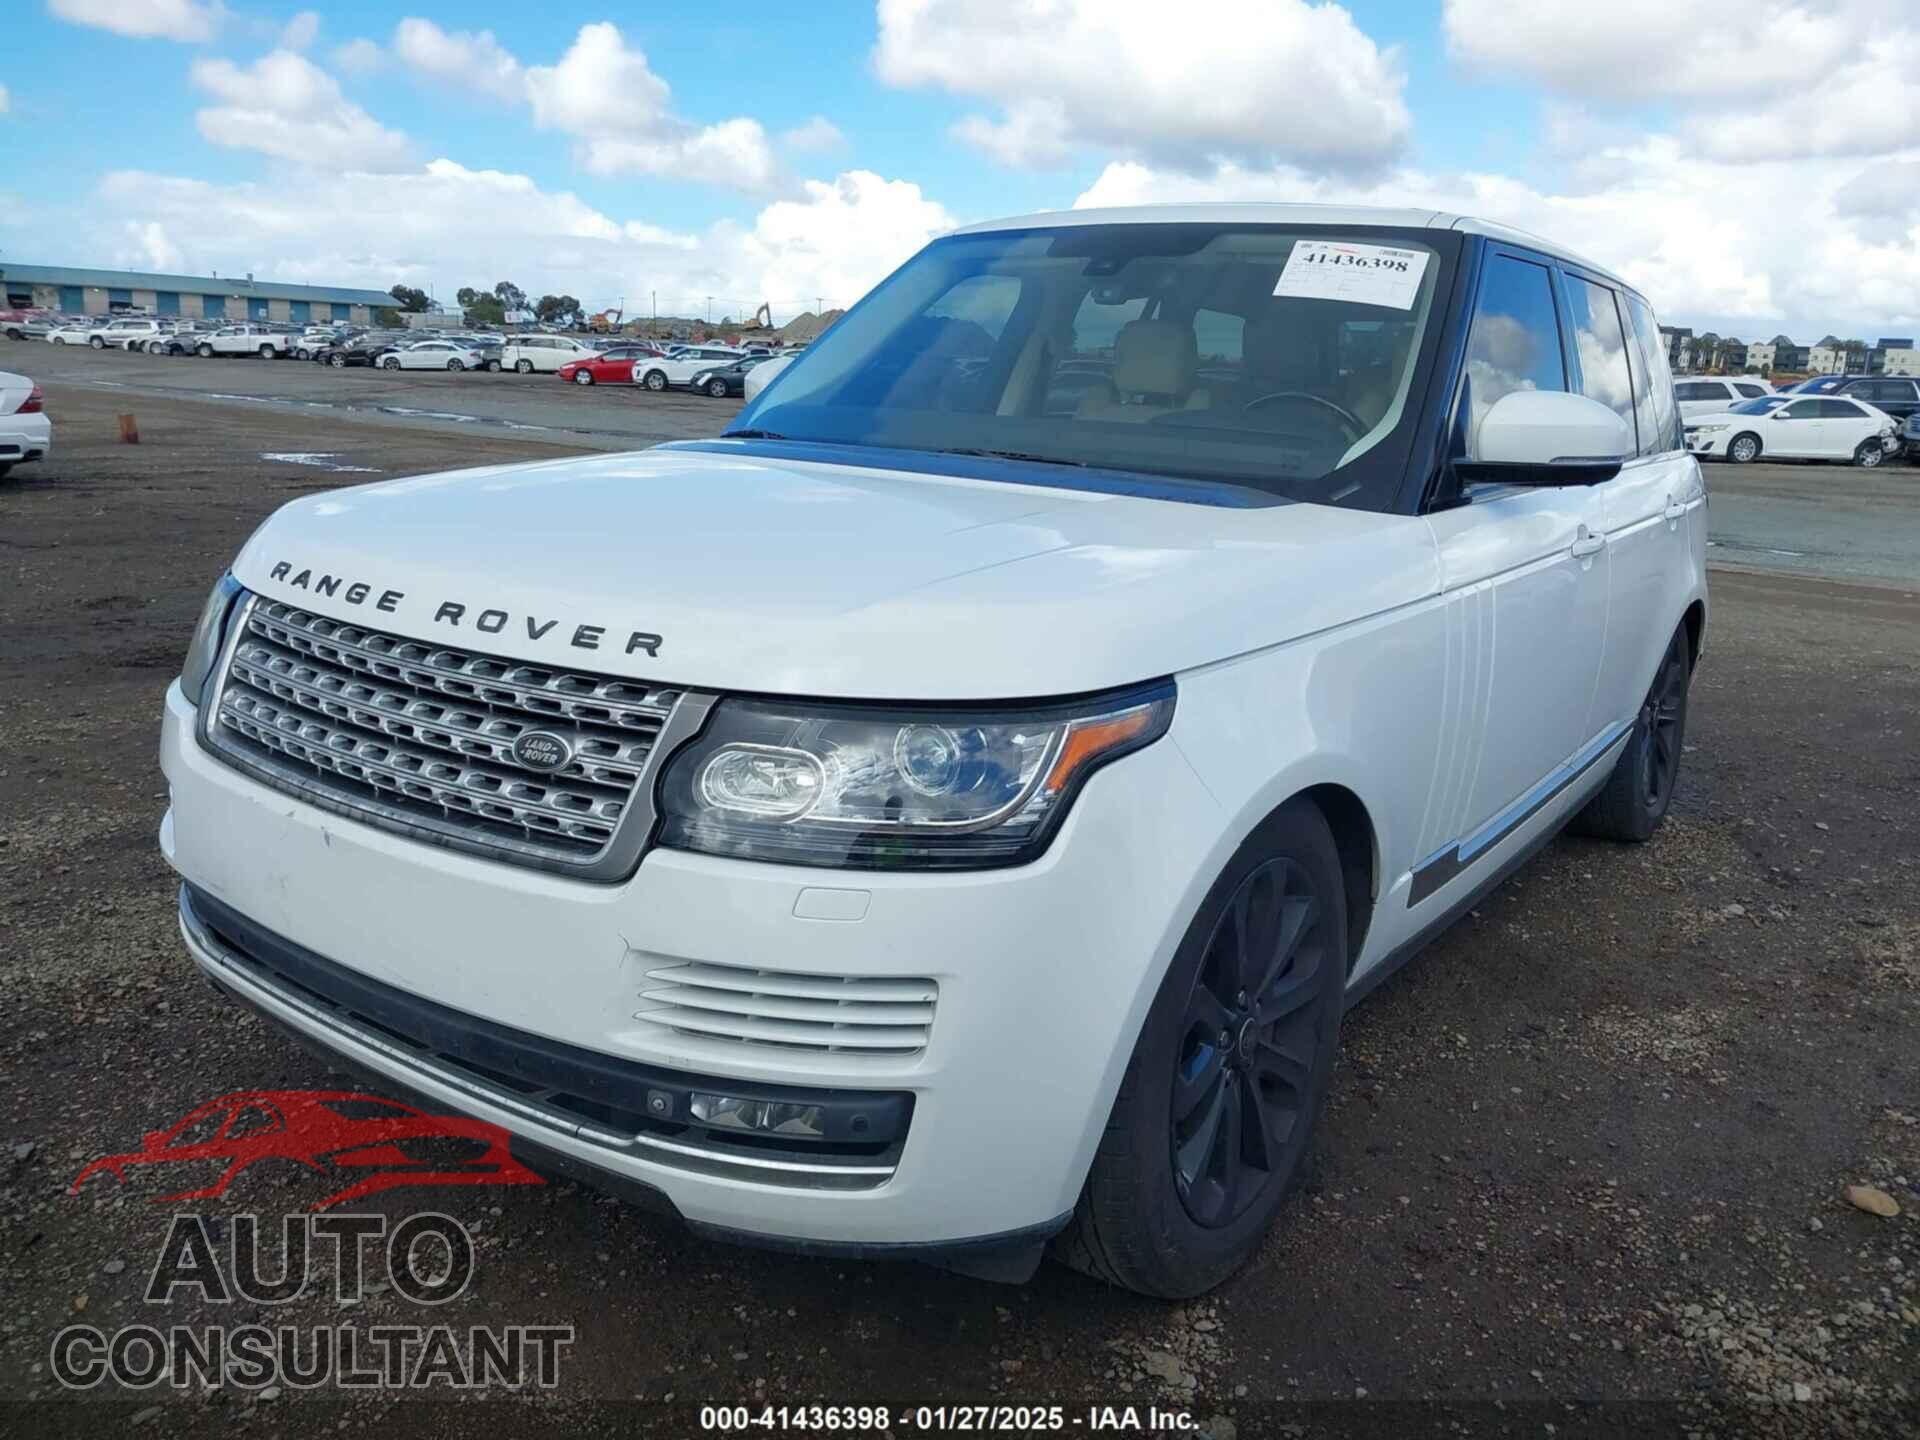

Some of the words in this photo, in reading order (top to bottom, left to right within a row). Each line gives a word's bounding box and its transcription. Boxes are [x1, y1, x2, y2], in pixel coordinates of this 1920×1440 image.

[1303, 253, 1408, 272] 41436398
[269, 560, 405, 613] RANGE
[434, 601, 664, 658] ROVER
